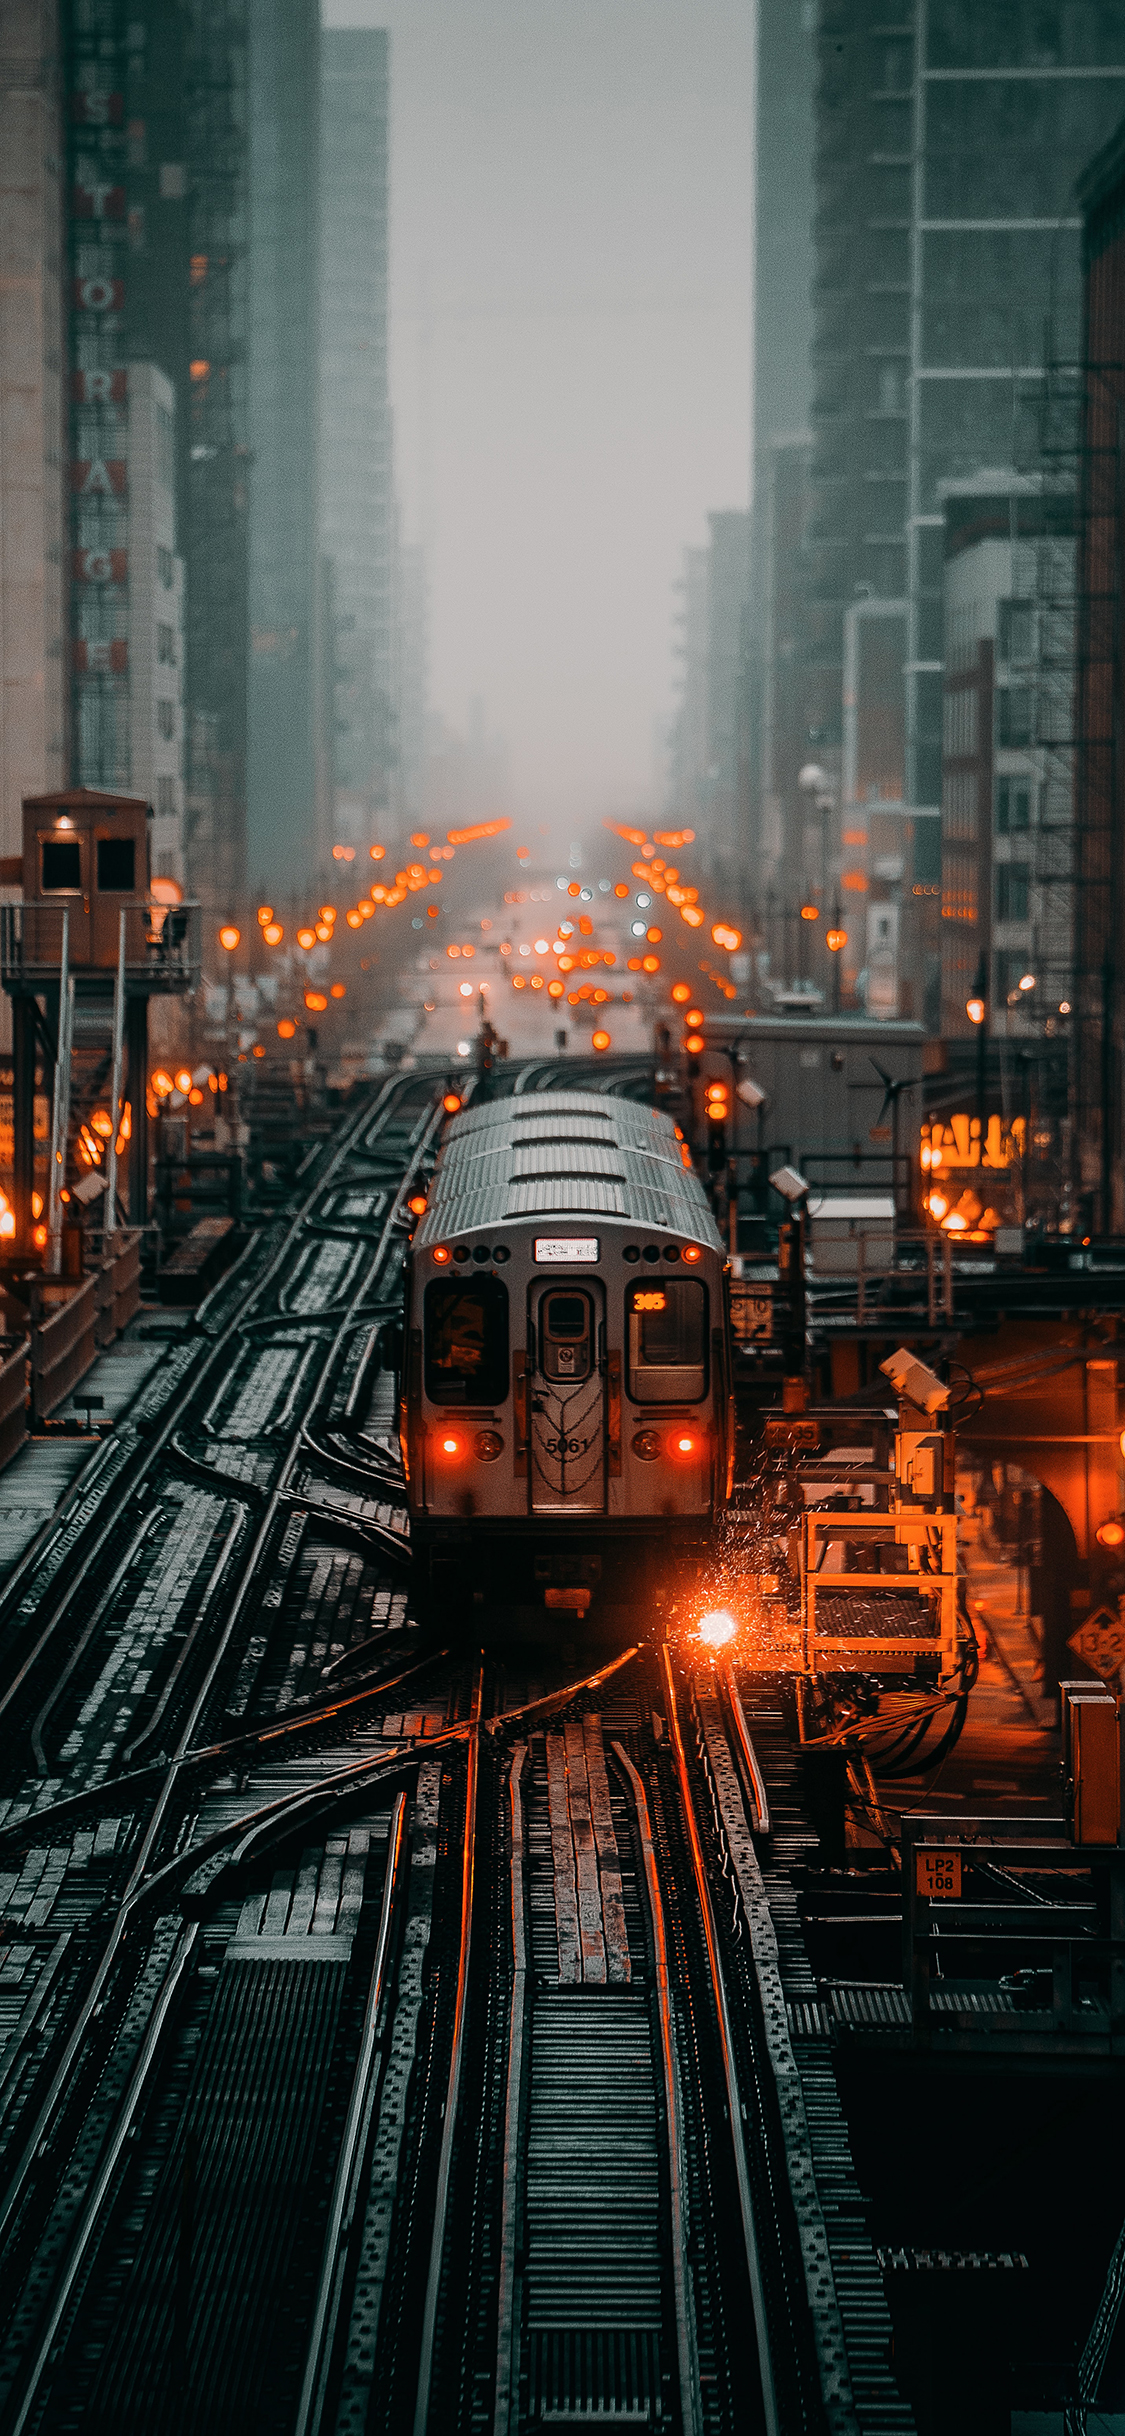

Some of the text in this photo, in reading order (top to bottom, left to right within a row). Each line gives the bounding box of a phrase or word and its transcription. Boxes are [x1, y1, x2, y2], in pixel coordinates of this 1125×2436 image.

[81, 91, 116, 672] STORAGE
[546, 1438, 588, 1453] 5061
[925, 1858, 954, 1872] LP2
[926, 1876, 953, 1890] 108
